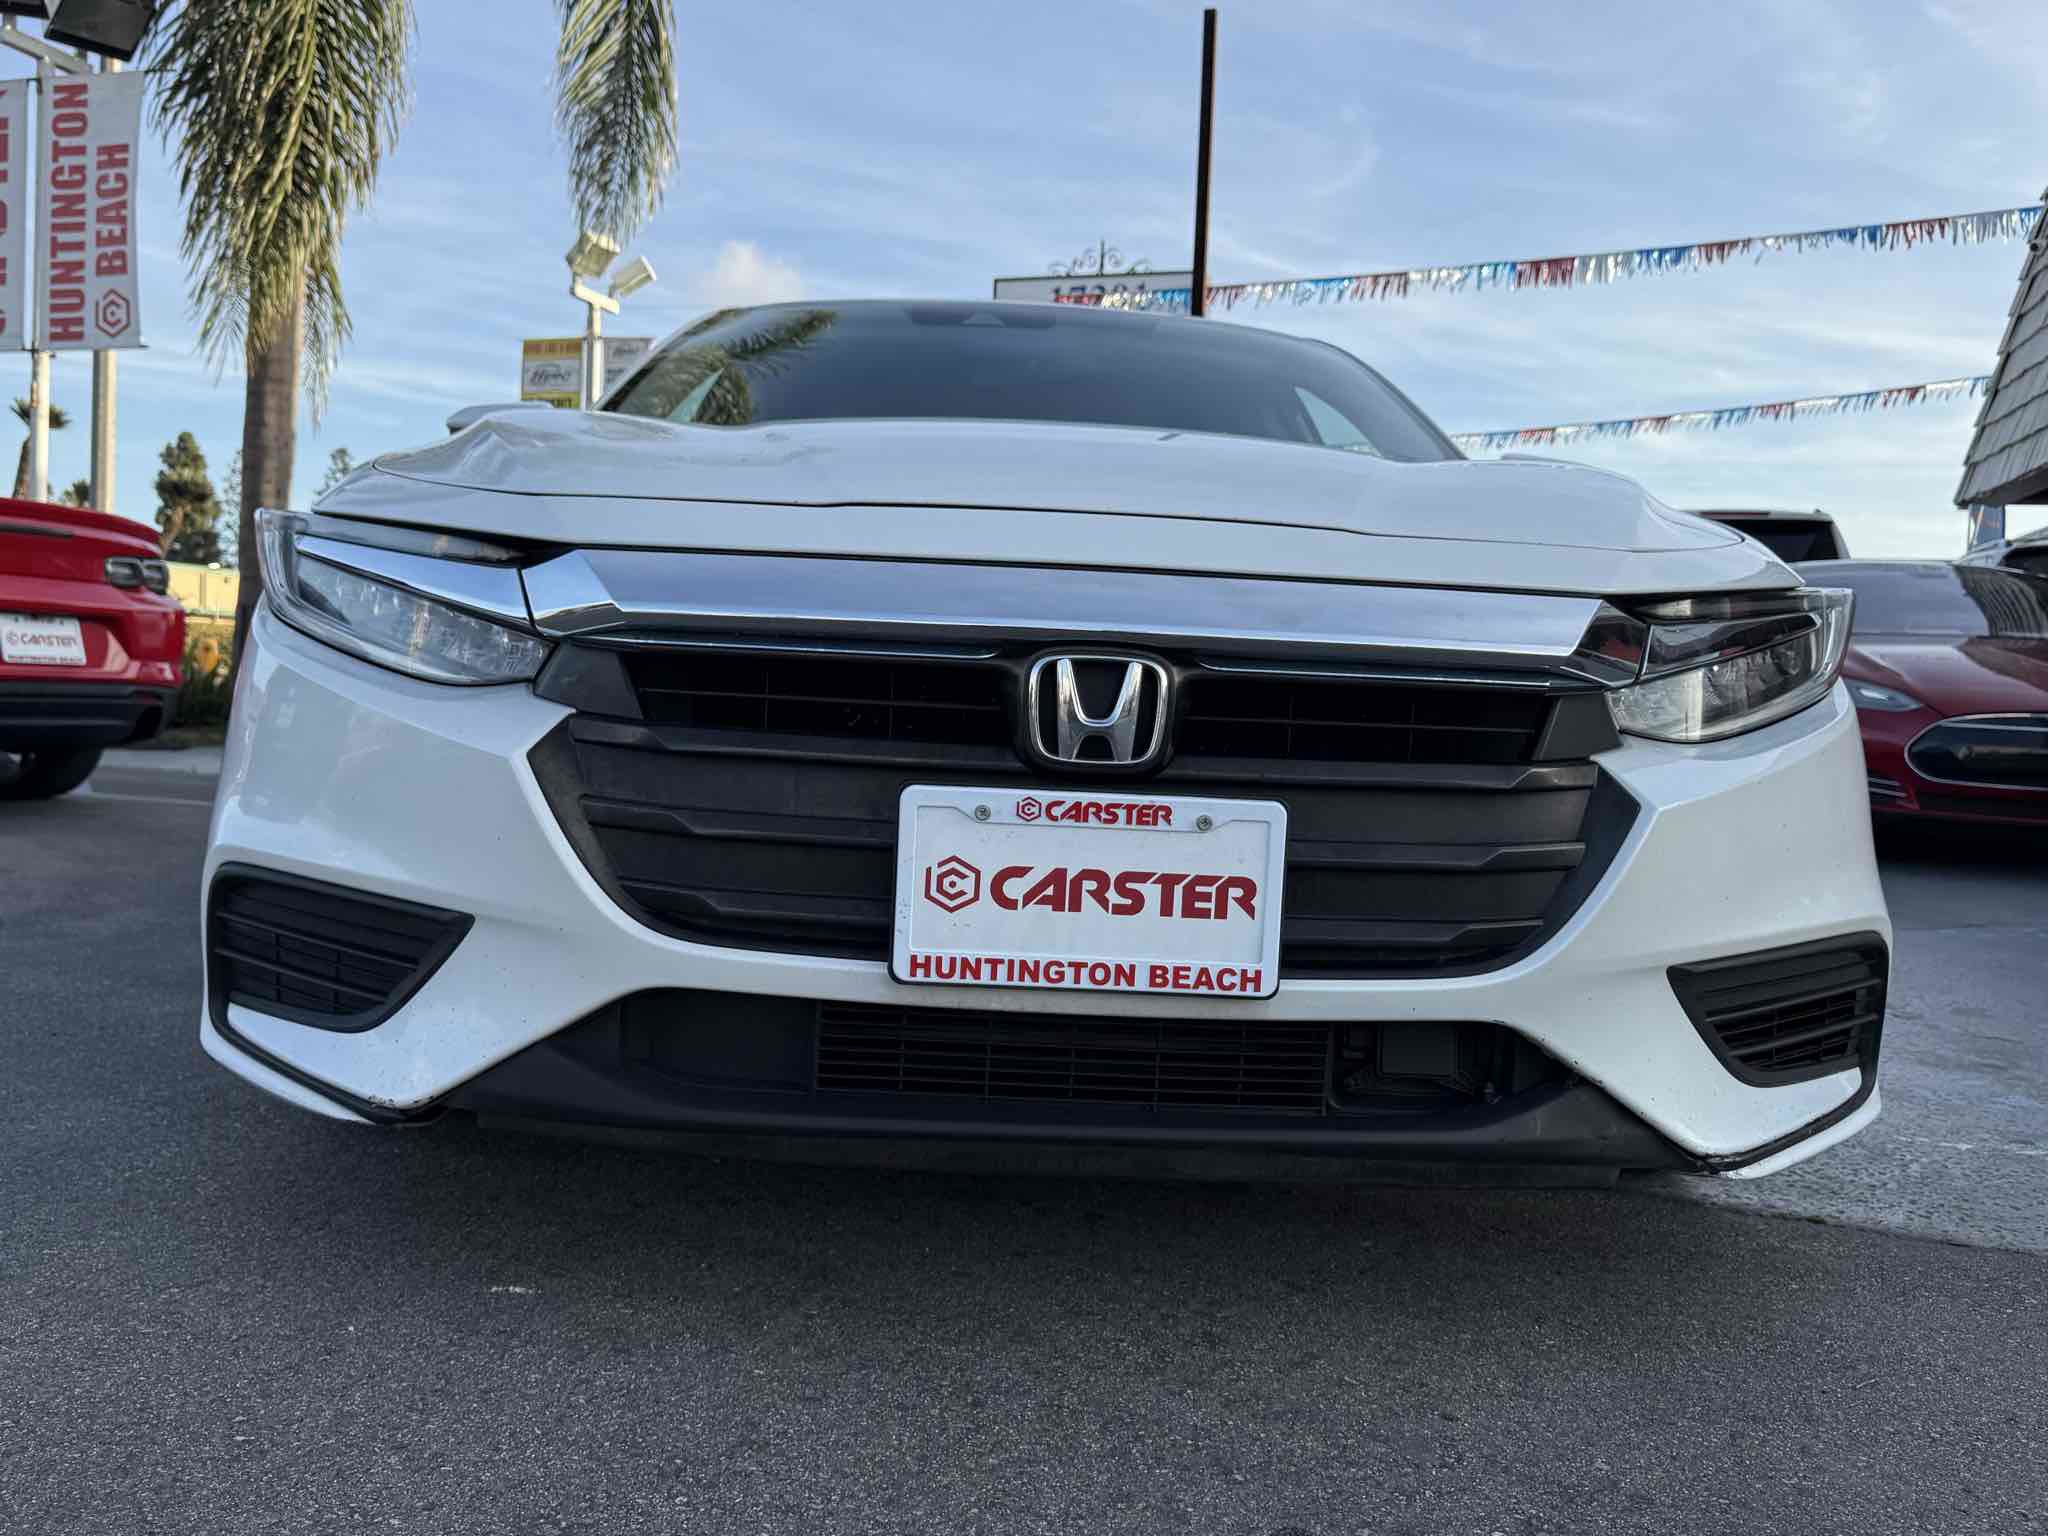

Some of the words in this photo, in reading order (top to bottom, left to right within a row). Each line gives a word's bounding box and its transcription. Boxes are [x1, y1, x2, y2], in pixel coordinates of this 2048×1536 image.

[48, 83, 89, 343] HUNTINGTON
[95, 143, 130, 278] BEACH
[1045, 799, 1172, 827] CARSTER
[989, 865, 1258, 921] CARSTER
[909, 953, 1137, 988] HUNTINGTON
[1148, 963, 1263, 993] BEACH
